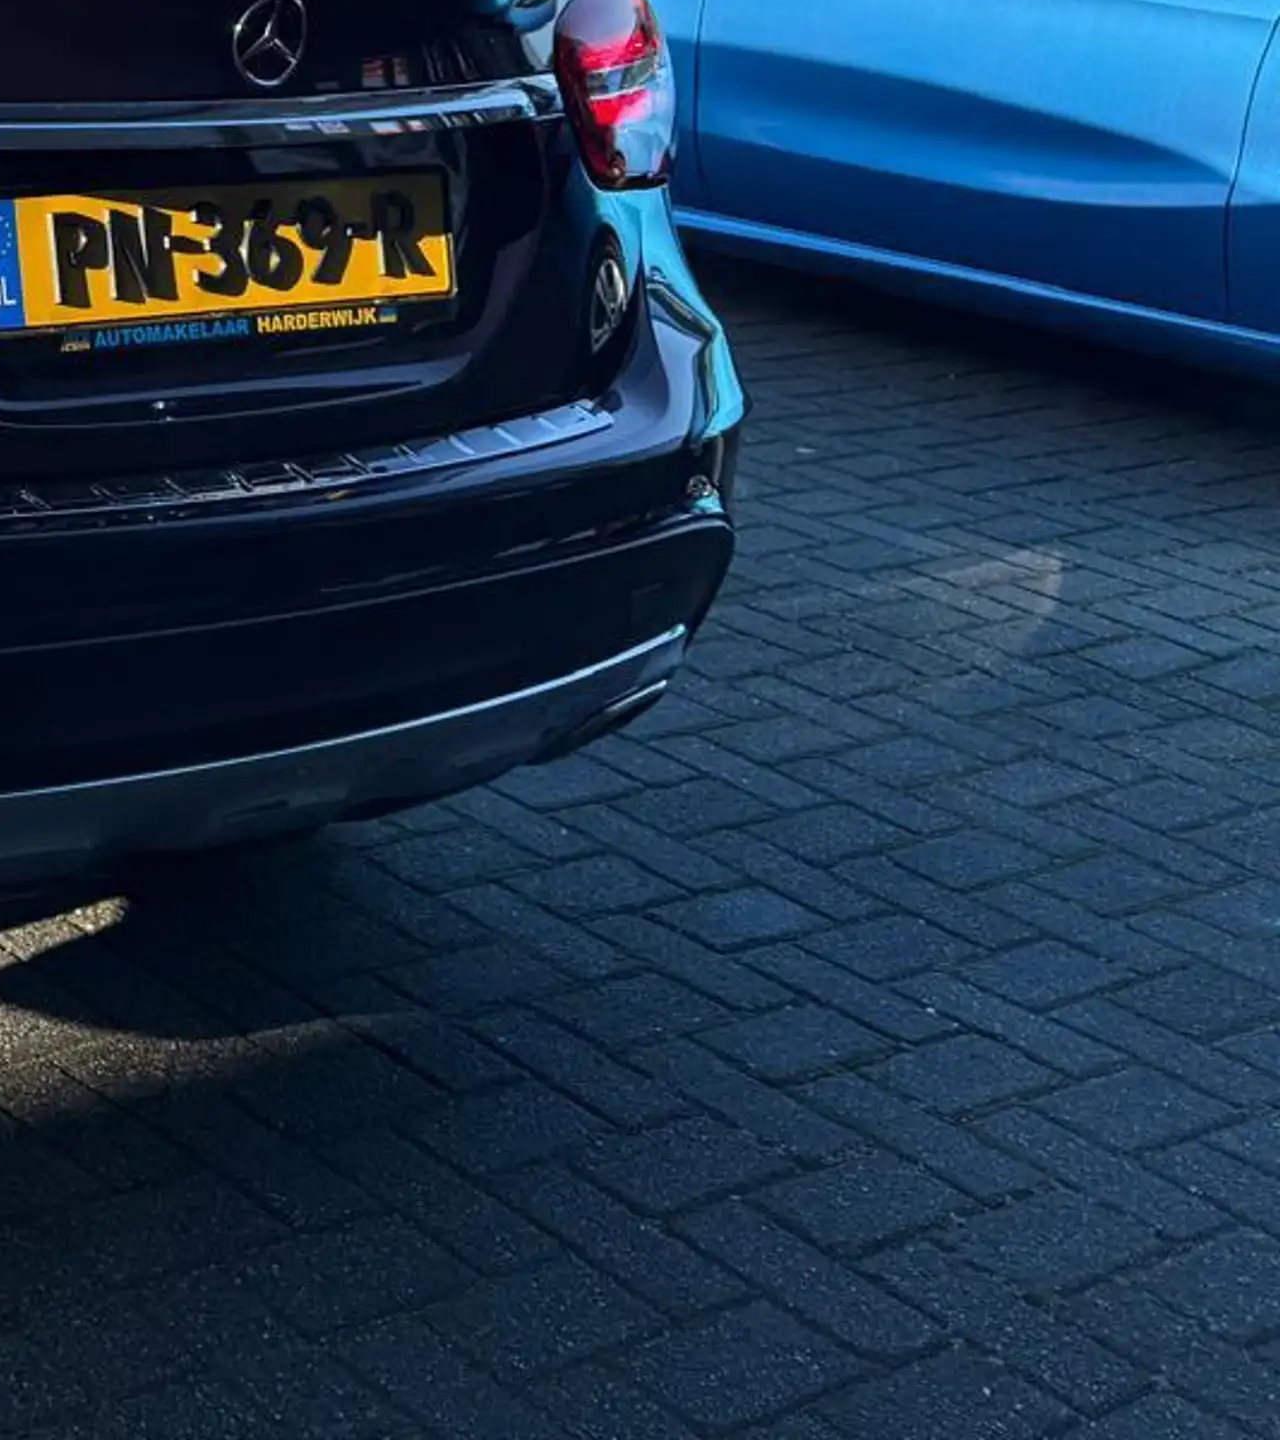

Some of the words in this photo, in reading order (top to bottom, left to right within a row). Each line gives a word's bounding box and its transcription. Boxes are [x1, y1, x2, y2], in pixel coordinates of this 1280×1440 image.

[47, 190, 437, 308] PN-369-R
[95, 318, 250, 348] AUTOMAKELAAR
[257, 307, 378, 334] HARDERWIJK
